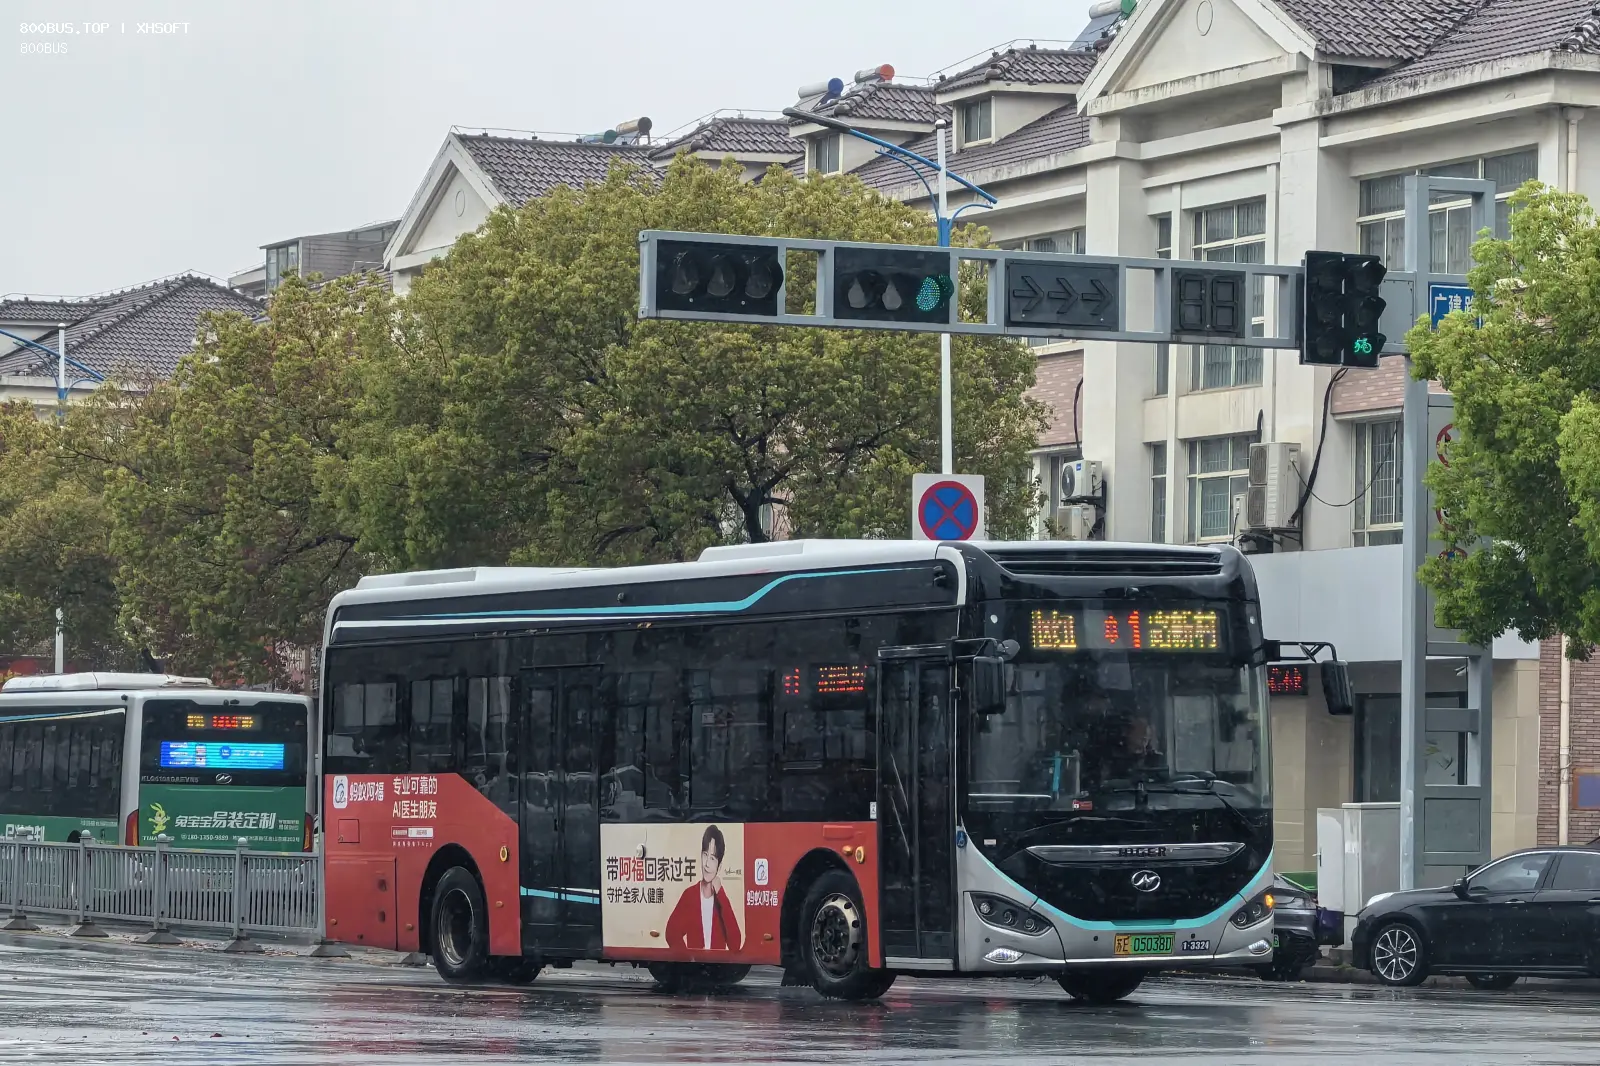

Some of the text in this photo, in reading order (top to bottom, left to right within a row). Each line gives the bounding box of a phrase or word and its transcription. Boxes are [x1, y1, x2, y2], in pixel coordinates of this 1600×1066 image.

[349, 782, 384, 802] 蚂蚁阿福
[392, 776, 438, 795] 专业可靠的
[392, 800, 438, 819] AI医生朋友
[175, 811, 276, 830] 兔宝宝易装定制
[606, 856, 697, 882] 带阿福回家过年
[606, 886, 664, 904] 守护全家人健康
[746, 890, 779, 906] 蚂蚁阿福
